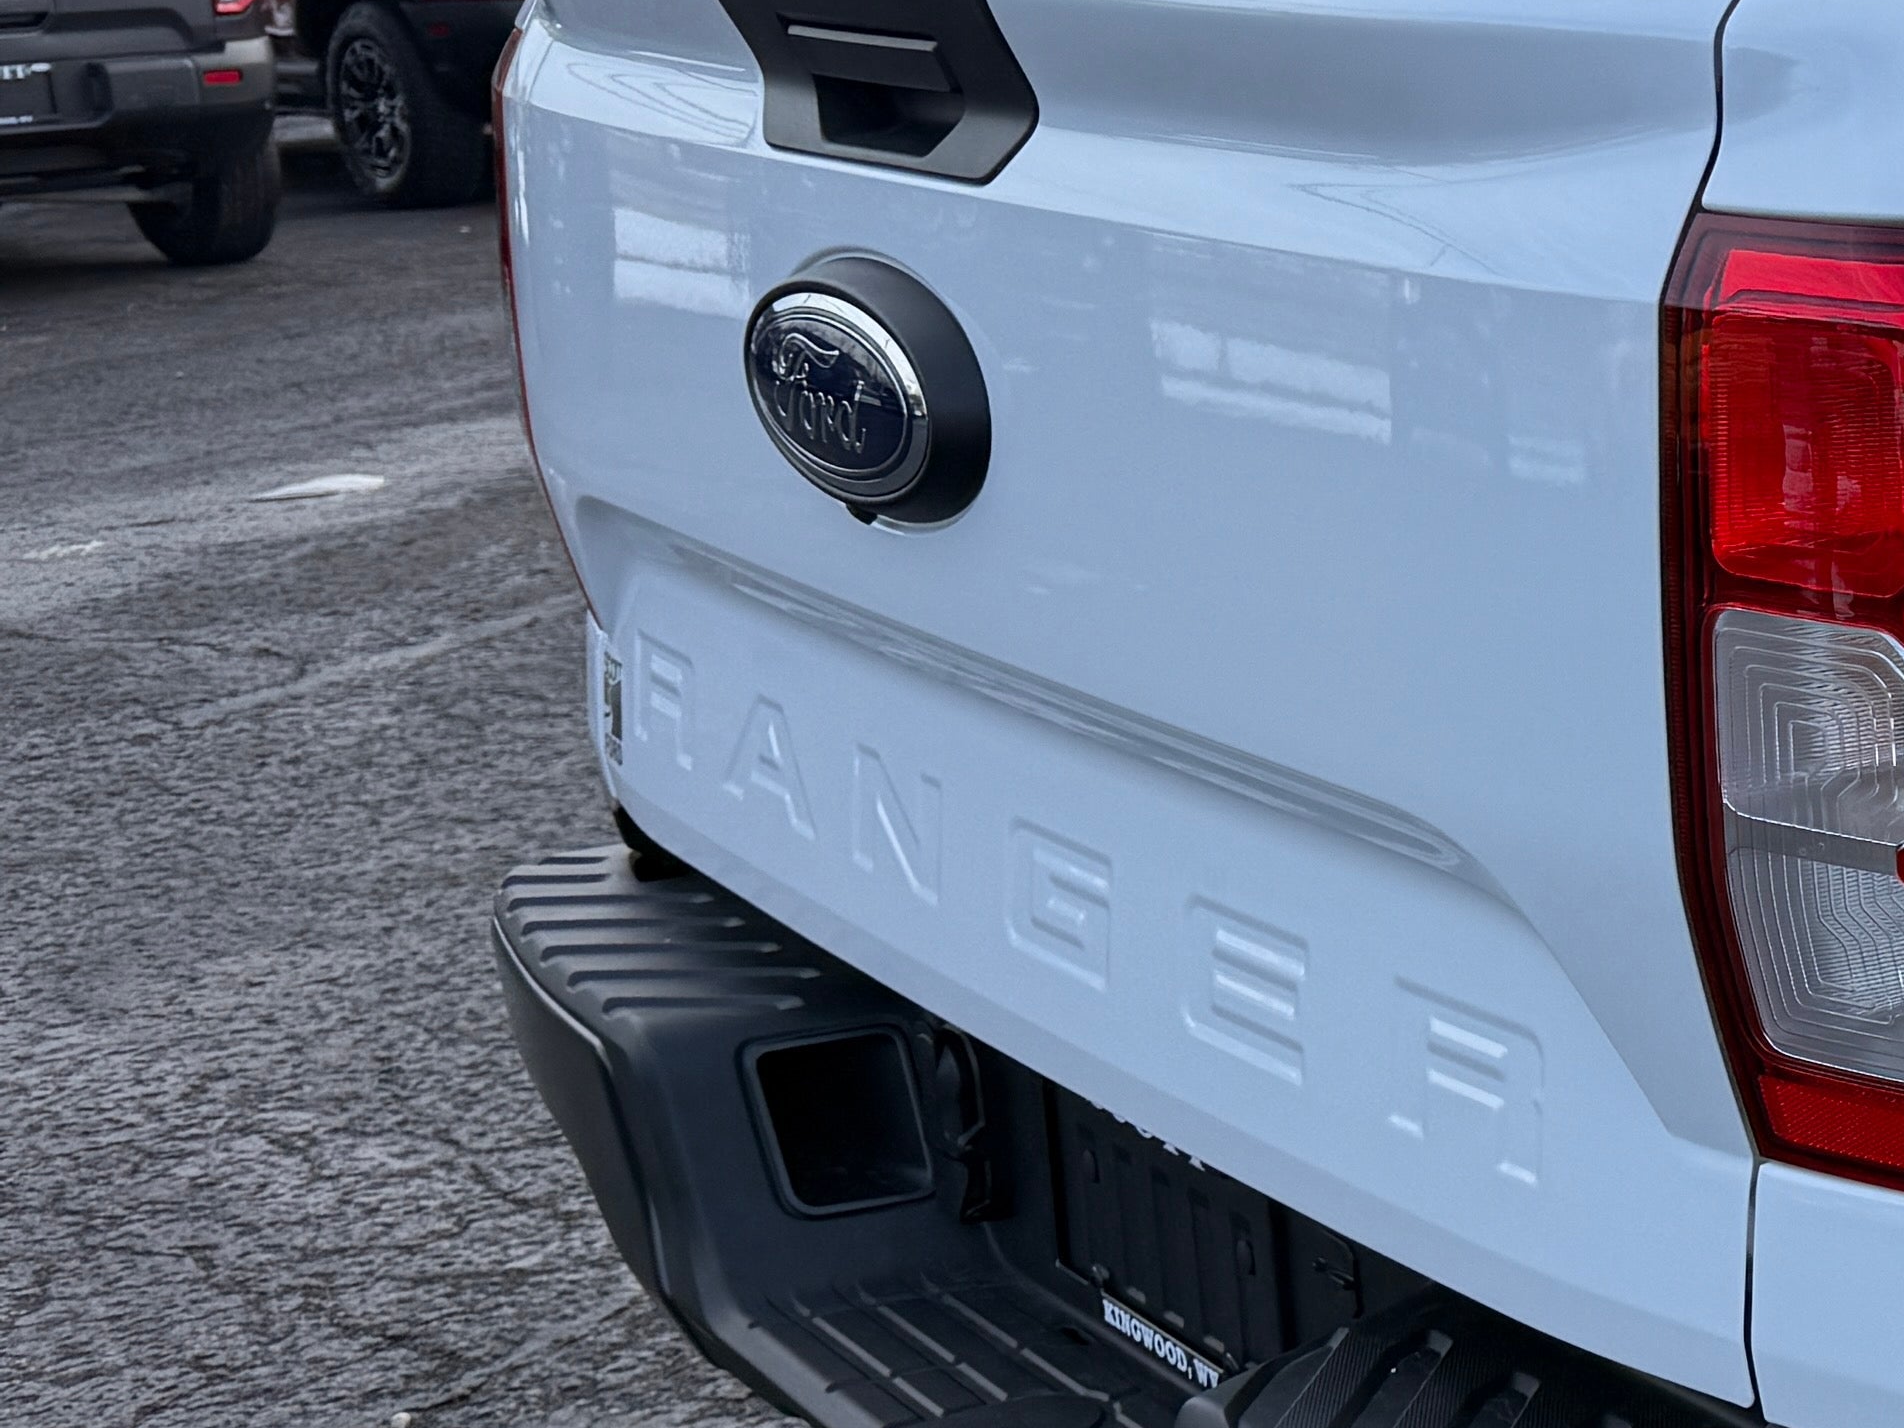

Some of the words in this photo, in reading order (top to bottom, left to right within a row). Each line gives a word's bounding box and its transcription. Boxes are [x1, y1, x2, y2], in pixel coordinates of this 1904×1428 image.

[771, 332, 867, 454] Ford
[635, 626, 1545, 1187] RANGER
[1102, 1298, 1193, 1380] KINGWOOD,
